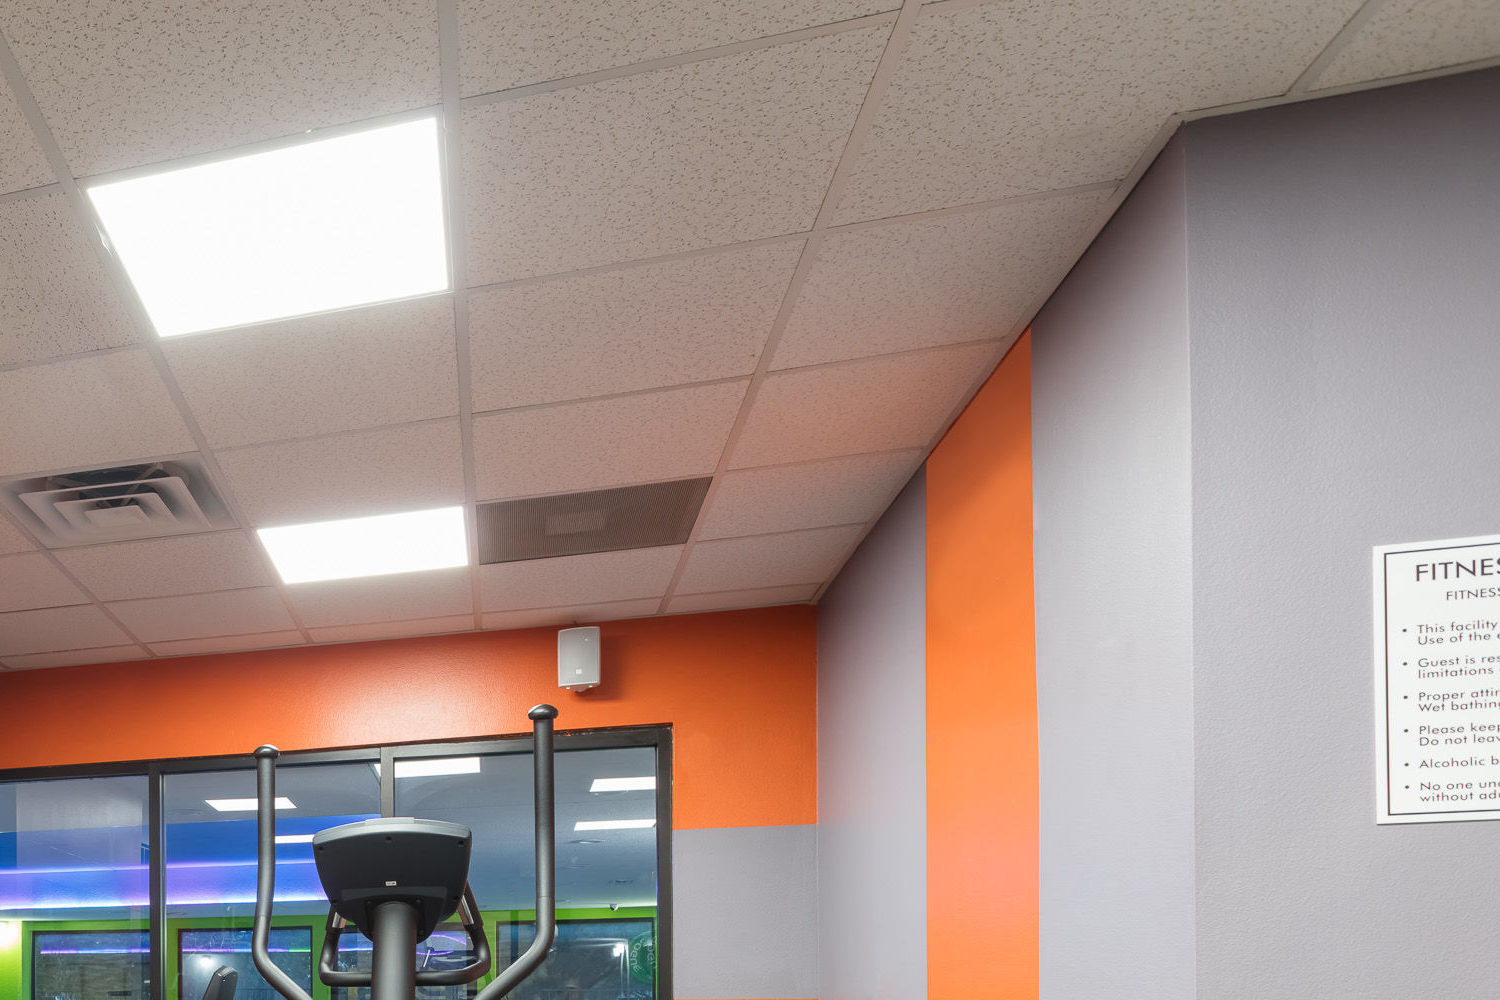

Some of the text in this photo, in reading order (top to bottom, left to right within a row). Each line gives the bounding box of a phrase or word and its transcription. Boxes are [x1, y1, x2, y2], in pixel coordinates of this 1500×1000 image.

[1417, 619, 1498, 634] This facility
[1417, 631, 1491, 646] Use of the
[1417, 656, 1460, 668] Guest
[1465, 655, 1476, 664] is
[1418, 667, 1494, 679] limitations
[1418, 691, 1465, 702] Proper
[1418, 699, 1500, 712] Wet bathin
[1419, 724, 1465, 735] Please
[1419, 736, 1439, 747] Do
[1444, 735, 1467, 745] not
[1419, 756, 1485, 769] Alcoholic
[1420, 781, 1441, 791] No
[1446, 782, 1473, 790] one
[1420, 789, 1500, 802] without ad
